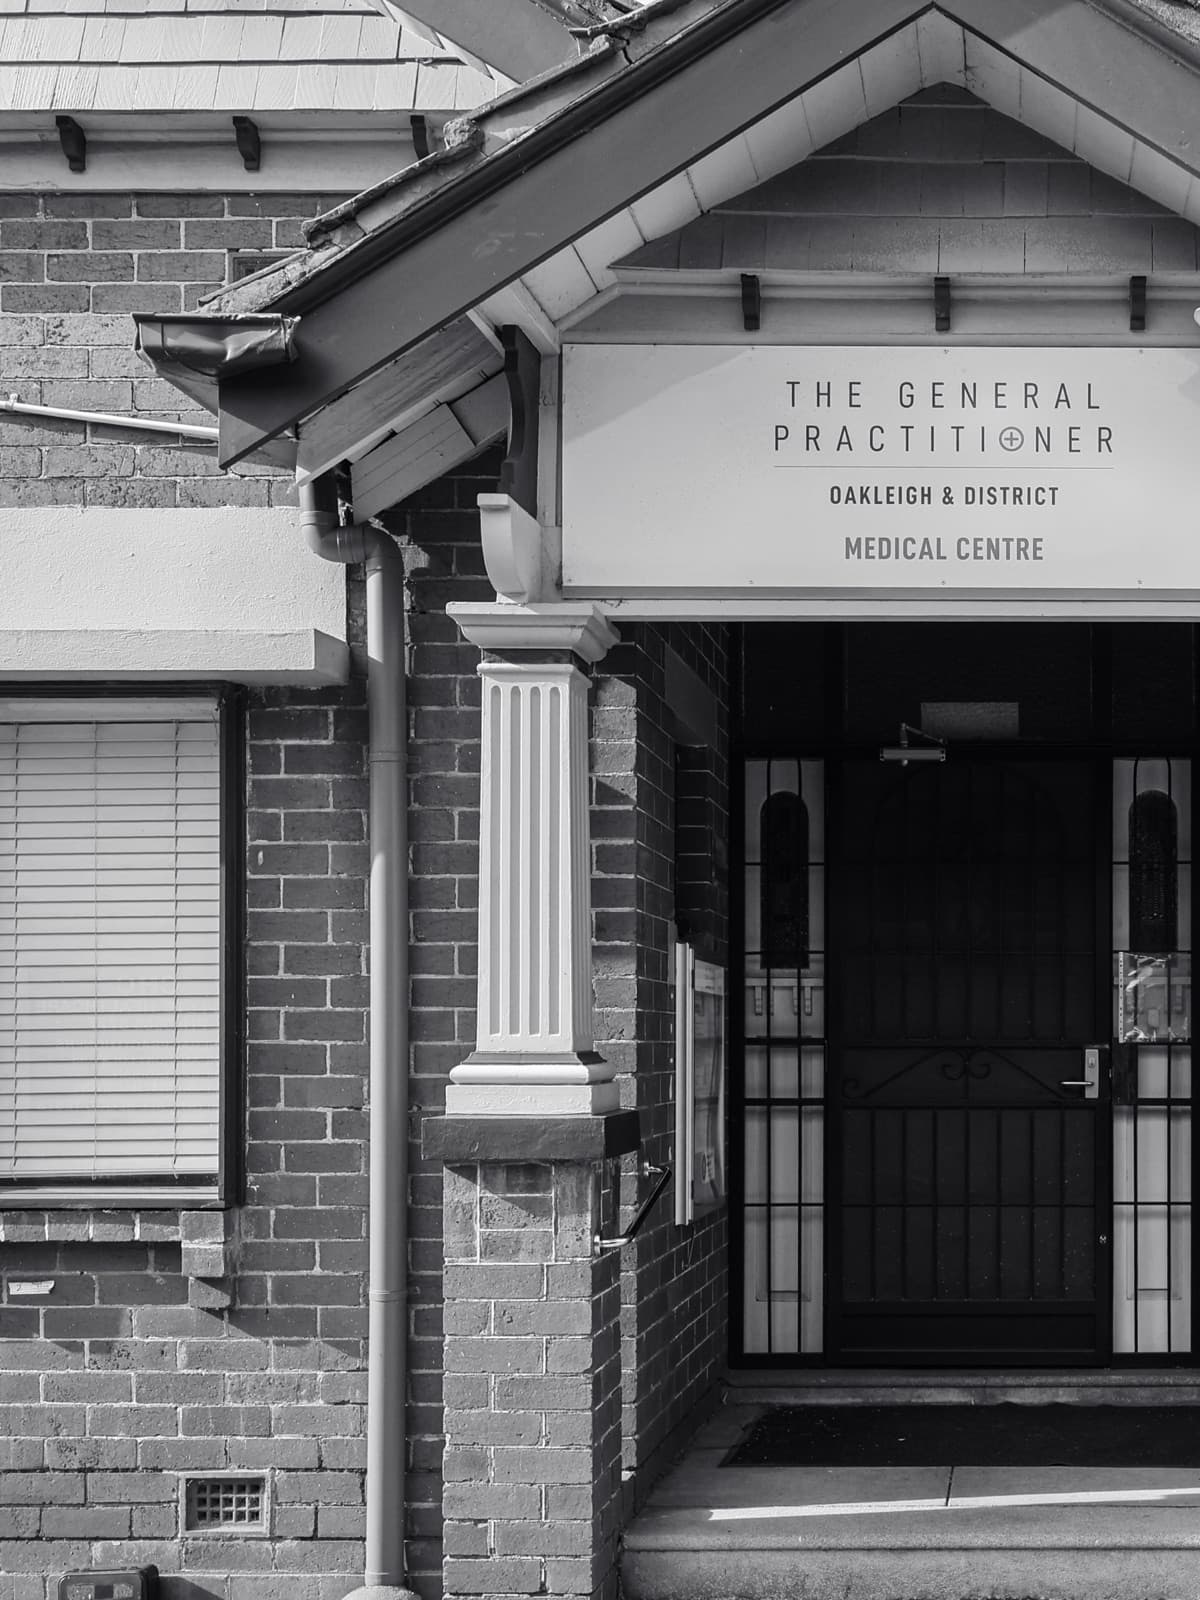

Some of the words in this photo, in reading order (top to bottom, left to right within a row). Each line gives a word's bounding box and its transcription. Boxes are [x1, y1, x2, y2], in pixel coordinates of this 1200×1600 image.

[785, 380, 862, 408] THE
[899, 381, 1101, 410] GENERAL
[774, 424, 1113, 454] PRACTITIONER
[829, 485, 932, 505] OAKLEIGH
[941, 485, 955, 506] &
[964, 486, 1059, 506] DISTRICT
[844, 536, 948, 561] MEDICAL
[956, 537, 1044, 561] CENTRE
